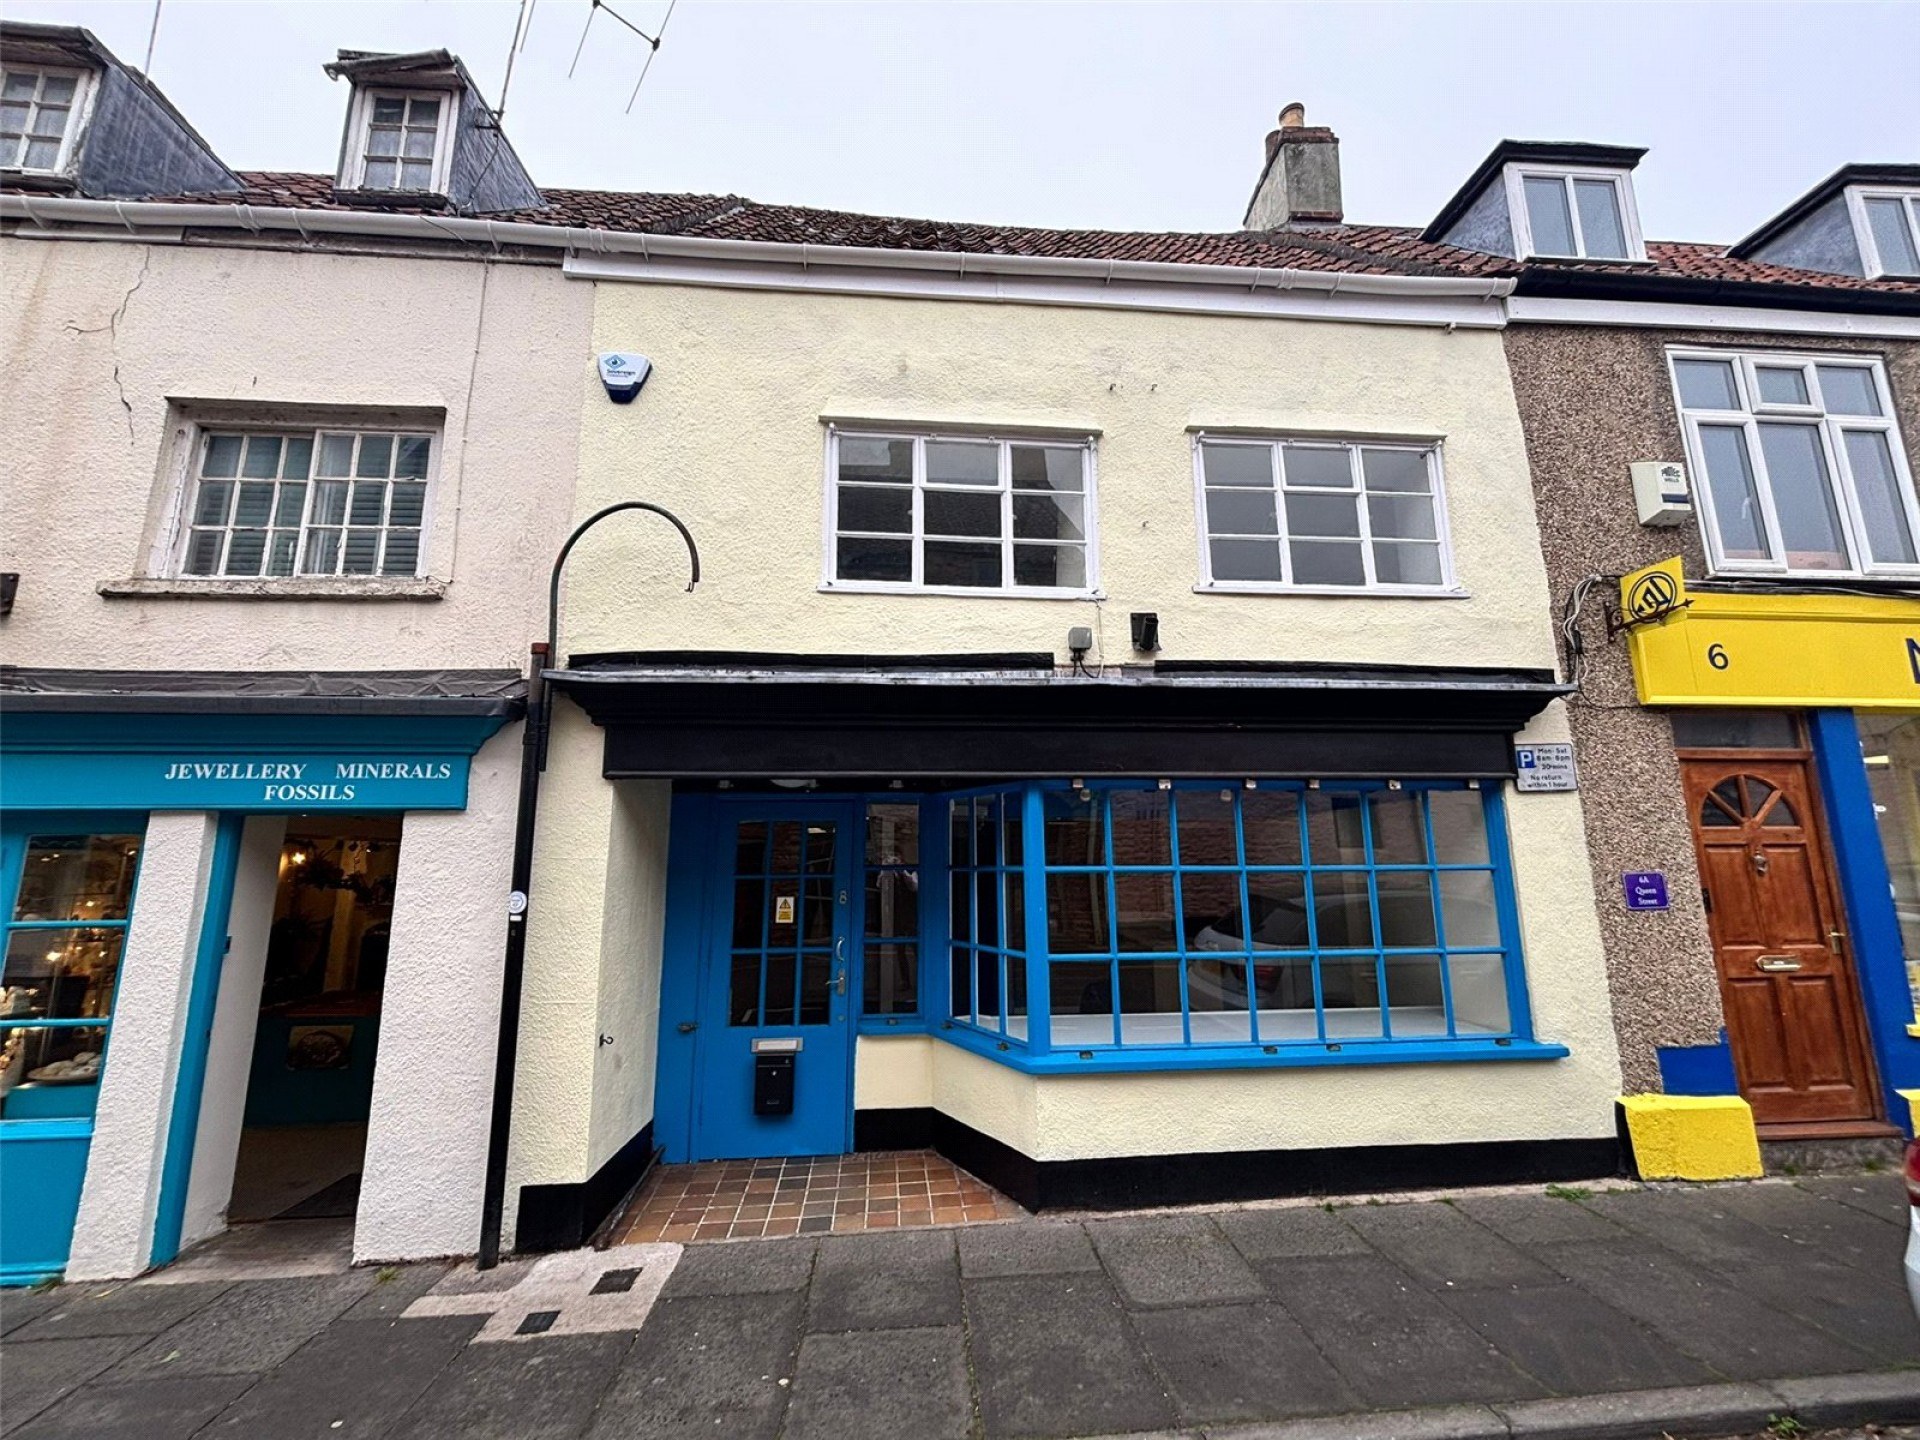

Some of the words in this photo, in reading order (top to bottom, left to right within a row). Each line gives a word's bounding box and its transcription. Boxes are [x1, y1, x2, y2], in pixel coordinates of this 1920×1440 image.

[1707, 643, 1729, 670] 6
[1520, 752, 1533, 767] P
[164, 763, 307, 780] JEWELLERY
[335, 763, 452, 780] MINERALS
[263, 784, 356, 801] FOSSILS
